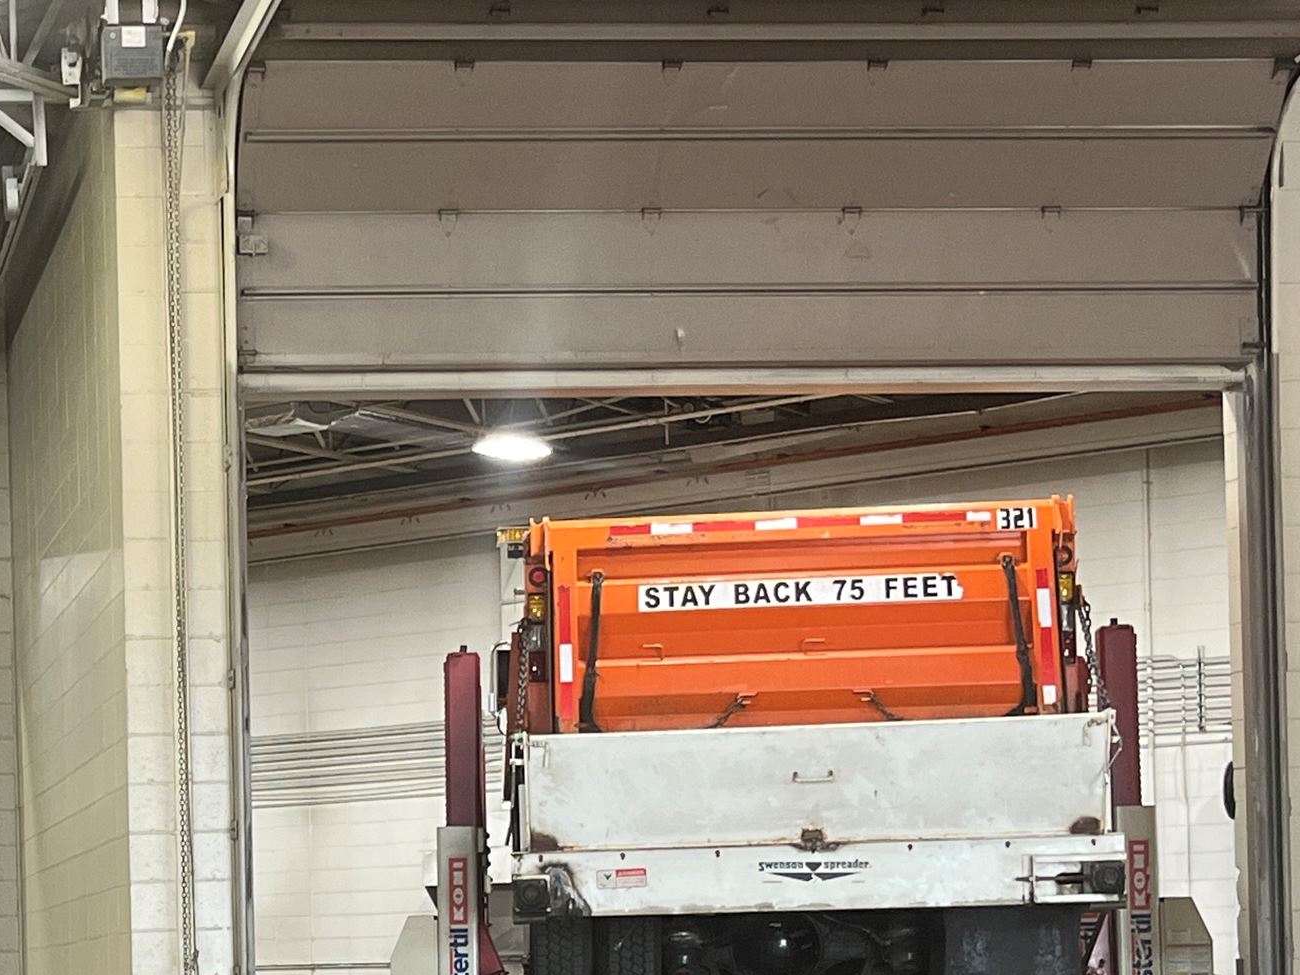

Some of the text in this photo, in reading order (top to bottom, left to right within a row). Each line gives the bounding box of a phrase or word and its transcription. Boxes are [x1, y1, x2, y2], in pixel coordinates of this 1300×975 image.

[1000, 508, 1034, 529] 321
[644, 575, 957, 608] STAY BACK 75 FEET
